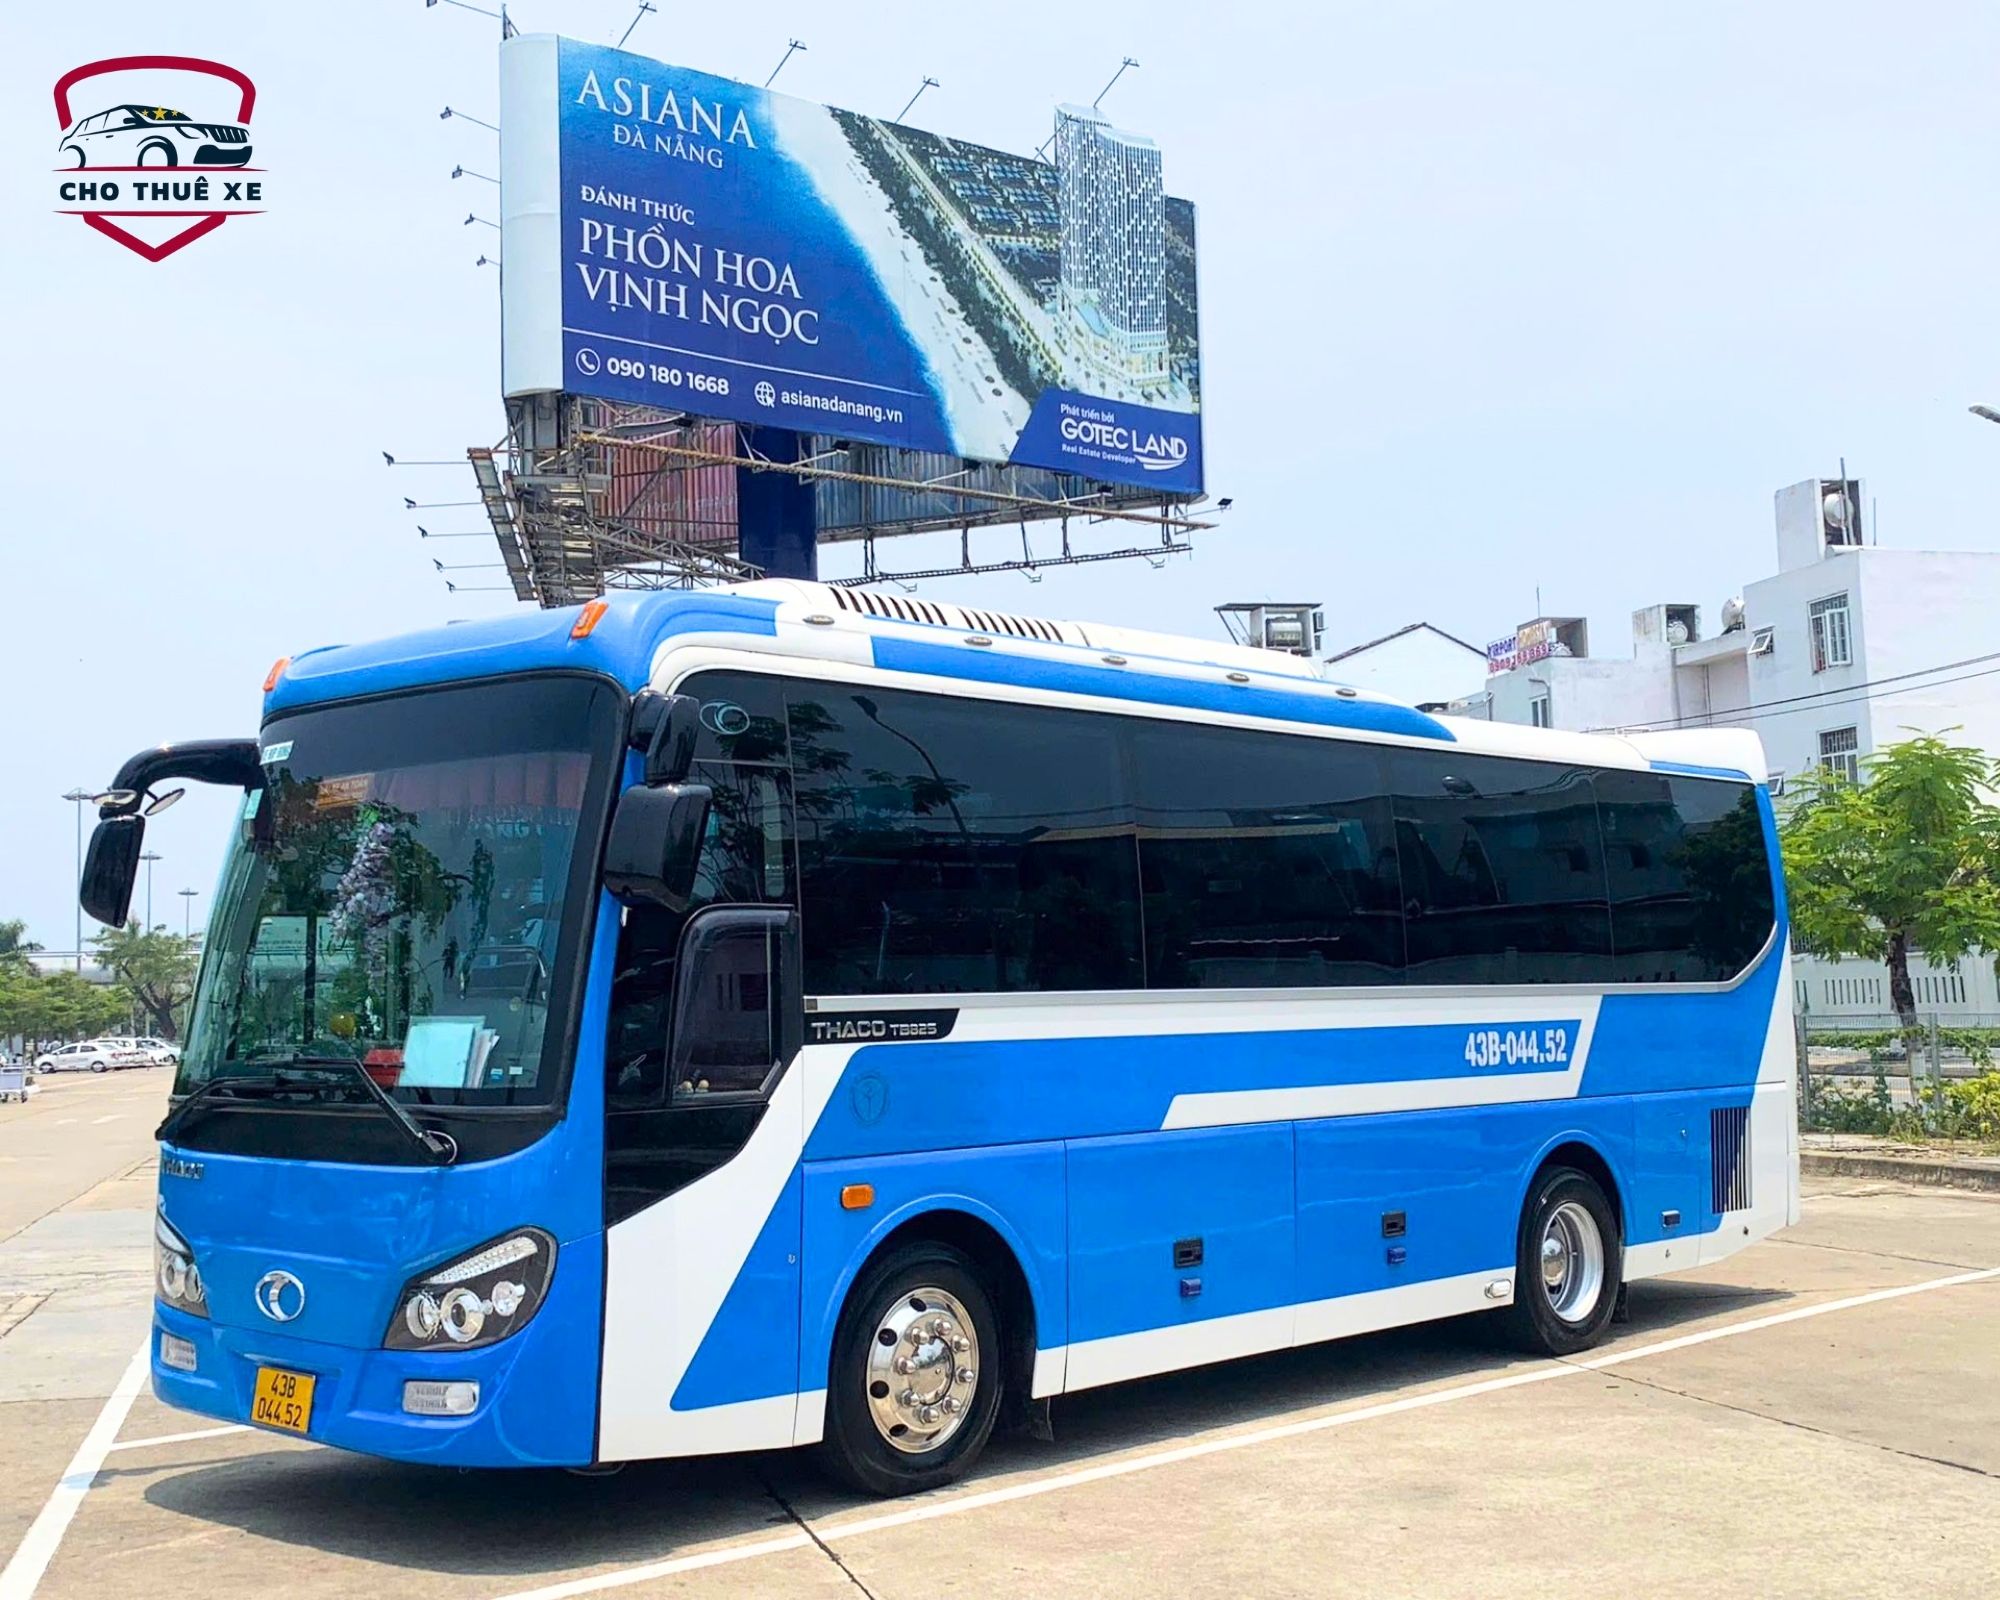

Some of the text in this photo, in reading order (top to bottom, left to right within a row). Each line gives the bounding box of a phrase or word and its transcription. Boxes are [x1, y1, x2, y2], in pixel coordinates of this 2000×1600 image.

[575, 69, 759, 150] ASIANA
[613, 124, 647, 150] ĐÀ
[581, 185, 696, 226] ĐÁNH THỨC
[580, 217, 804, 300] PHỒN HOA
[575, 262, 820, 346] VỊNH NGỌC
[607, 357, 730, 395] 090 180 1668
[781, 389, 903, 424] asianadanang.vn
[1061, 403, 1080, 417] Phát
[1061, 417, 1188, 459] GOTEC LAND
[1061, 443, 1137, 465] Real Estate Developer
[811, 1020, 887, 1039] THACO
[1465, 1028, 1567, 1067] 43B-044.52
[270, 1372, 297, 1398] 43B
[257, 1397, 303, 1427] 044.52
